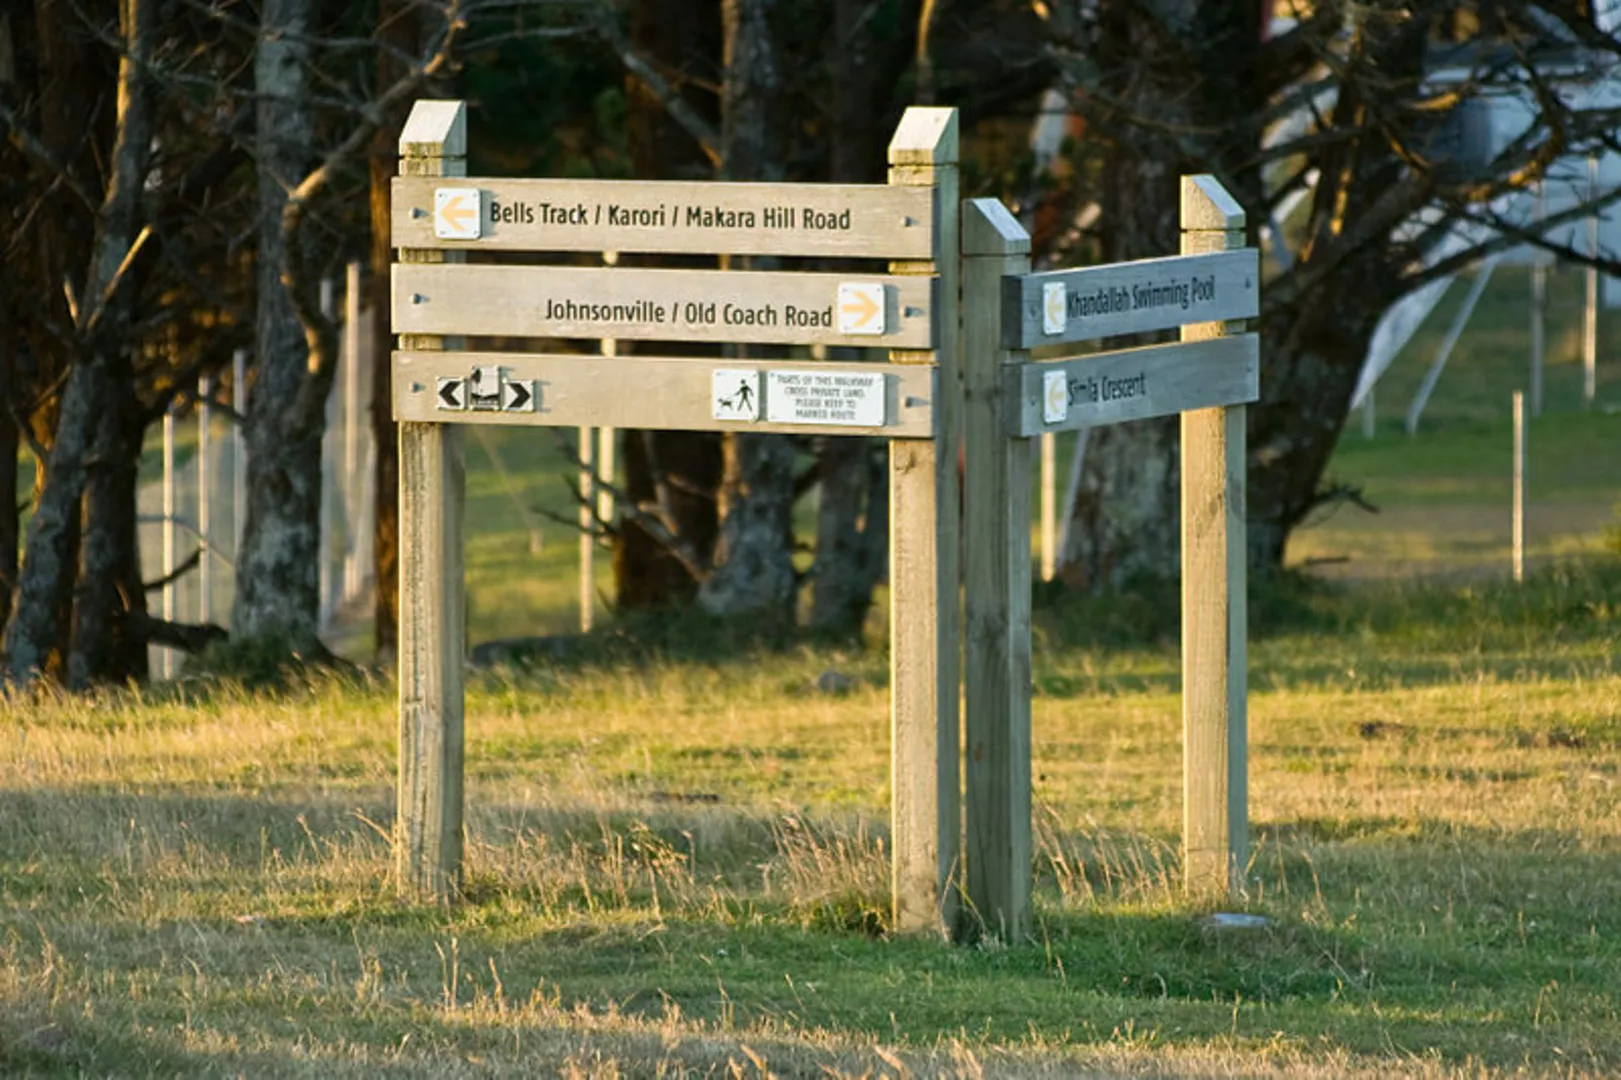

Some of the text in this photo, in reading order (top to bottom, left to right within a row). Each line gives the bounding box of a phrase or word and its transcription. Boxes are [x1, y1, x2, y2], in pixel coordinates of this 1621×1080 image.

[490, 202, 851, 230] Bells Track / Karori / Makara Hill Road
[1068, 275, 1215, 318] Khandallah Swimming Pool
[545, 299, 833, 327] Johnsonville / Old Coach Road
[1101, 372, 1146, 402] Crescent
